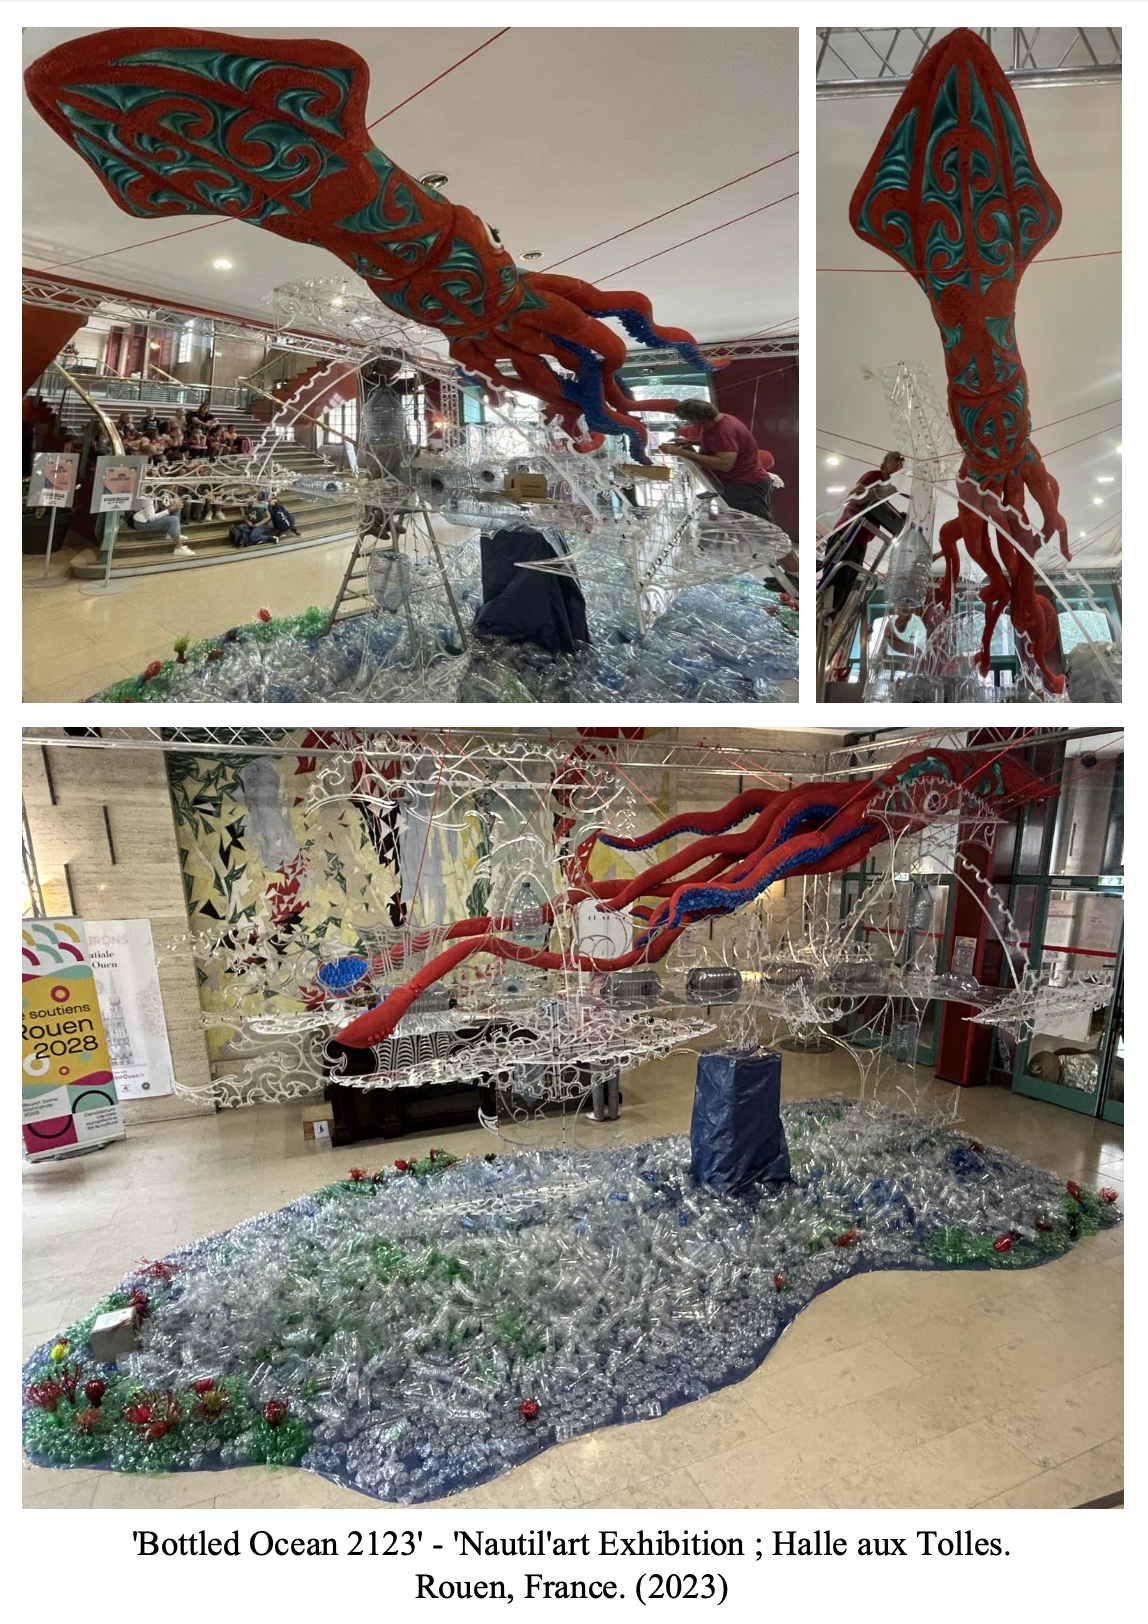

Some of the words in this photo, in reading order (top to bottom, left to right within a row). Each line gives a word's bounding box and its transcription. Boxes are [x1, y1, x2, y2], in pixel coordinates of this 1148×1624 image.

[91, 960, 118, 969] Ouen
[29, 1004, 91, 1019] soutiens
[33, 1035, 99, 1060] 2028
